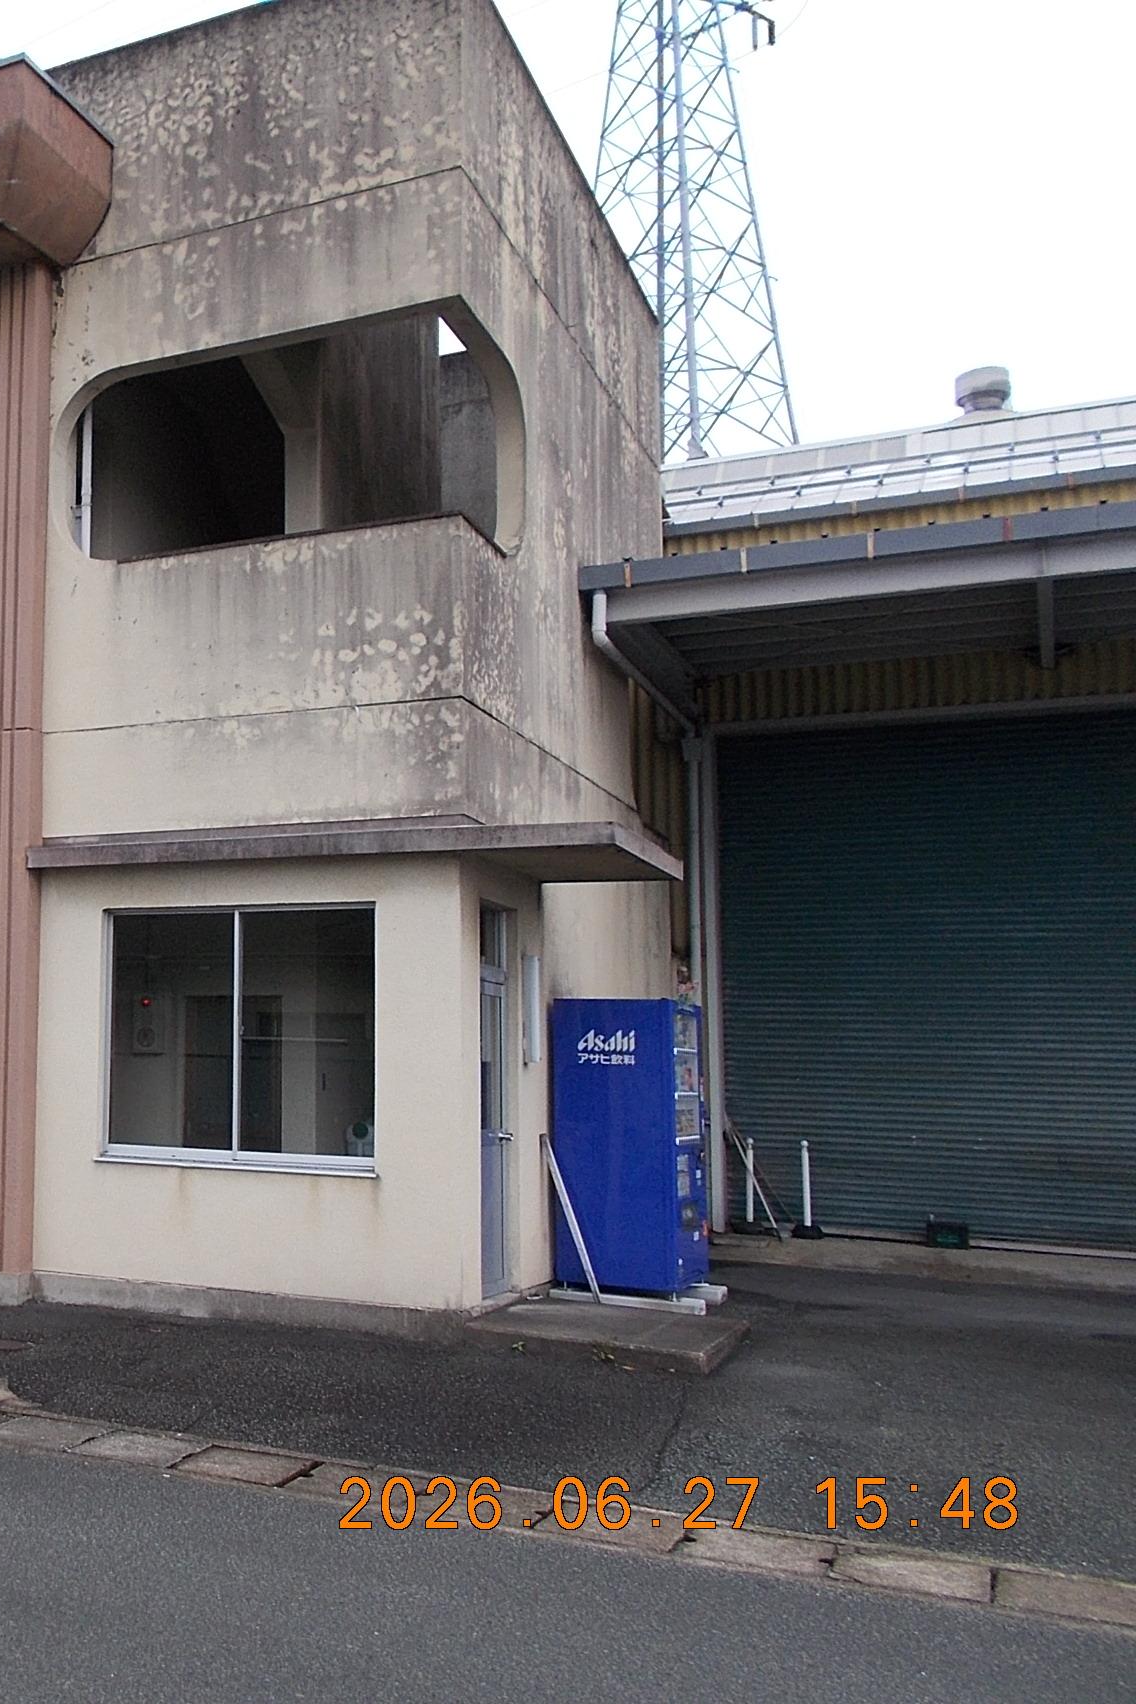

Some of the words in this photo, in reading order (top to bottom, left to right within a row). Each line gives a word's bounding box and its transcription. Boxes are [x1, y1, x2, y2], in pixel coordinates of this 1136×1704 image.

[577, 1028, 635, 1052] Asahi
[577, 1053, 635, 1066] アサヒ飲料
